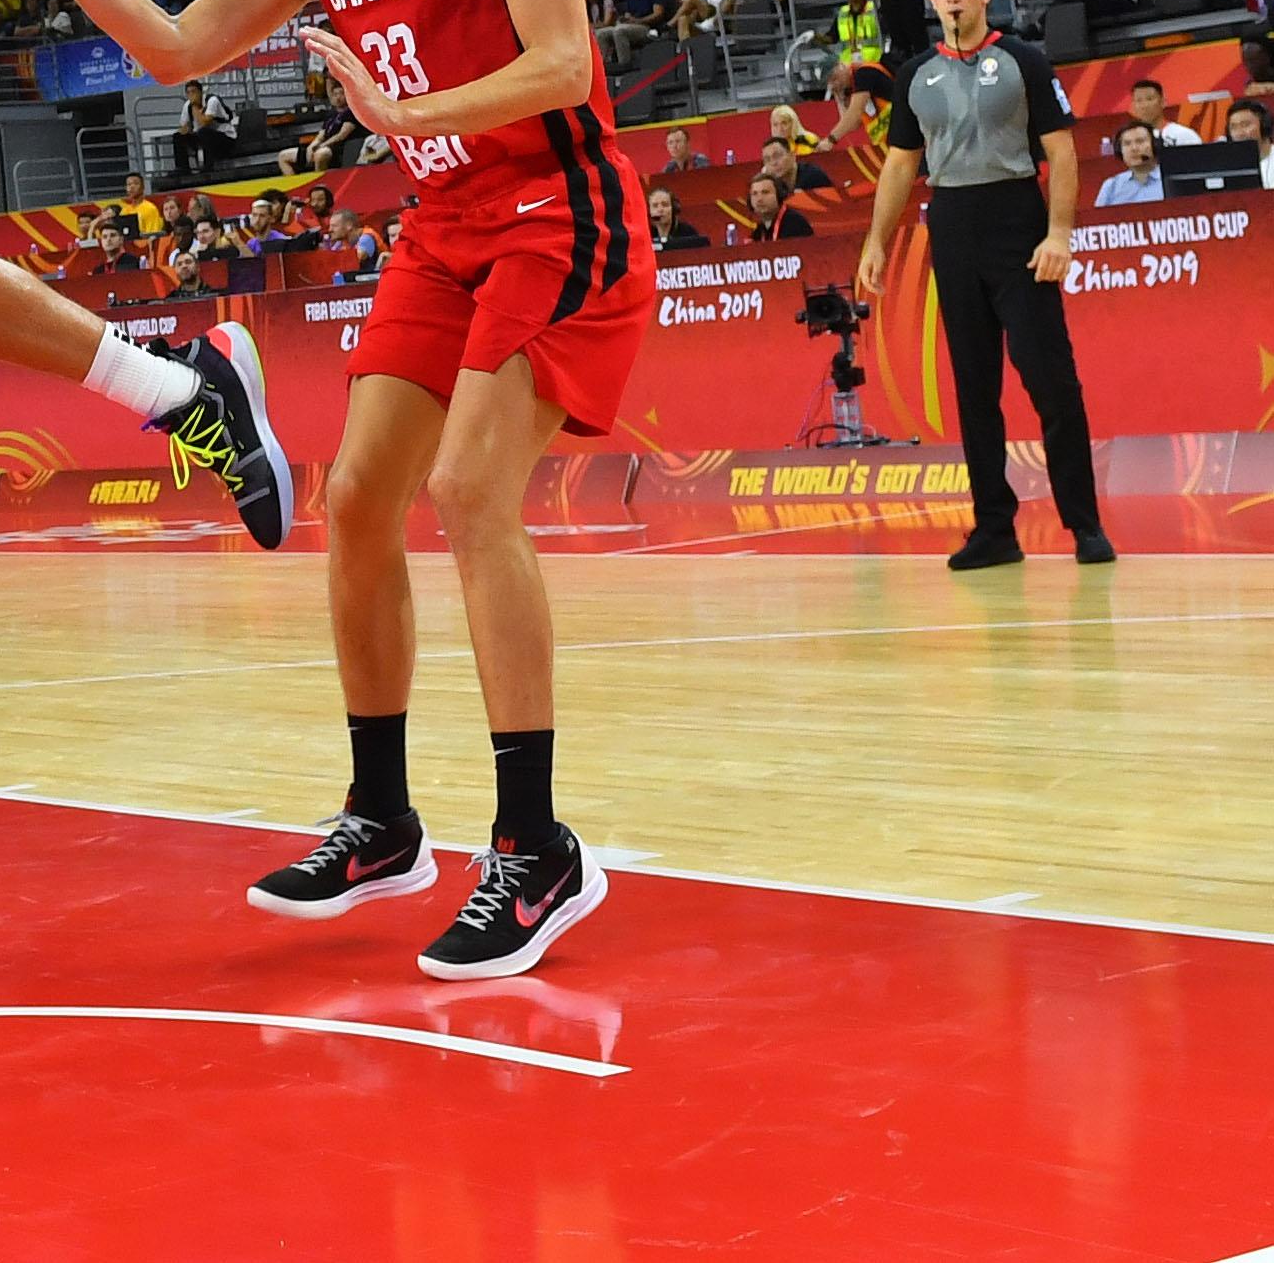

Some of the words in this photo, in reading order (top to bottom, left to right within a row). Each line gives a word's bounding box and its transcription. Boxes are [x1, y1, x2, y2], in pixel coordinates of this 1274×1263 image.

[360, 22, 429, 102] 33
[1148, 214, 1211, 245] WORLD
[1212, 210, 1249, 240] CUP
[724, 259, 771, 284] WORLD
[774, 255, 801, 281] CUP
[1063, 259, 1138, 295] China
[1141, 249, 1199, 287] 2019
[305, 302, 327, 323] FIBA
[658, 292, 716, 327] China
[718, 289, 763, 323] 2019
[729, 466, 768, 496] THE
[771, 458, 871, 495] WORLD'S
[875, 464, 922, 494] GOT
